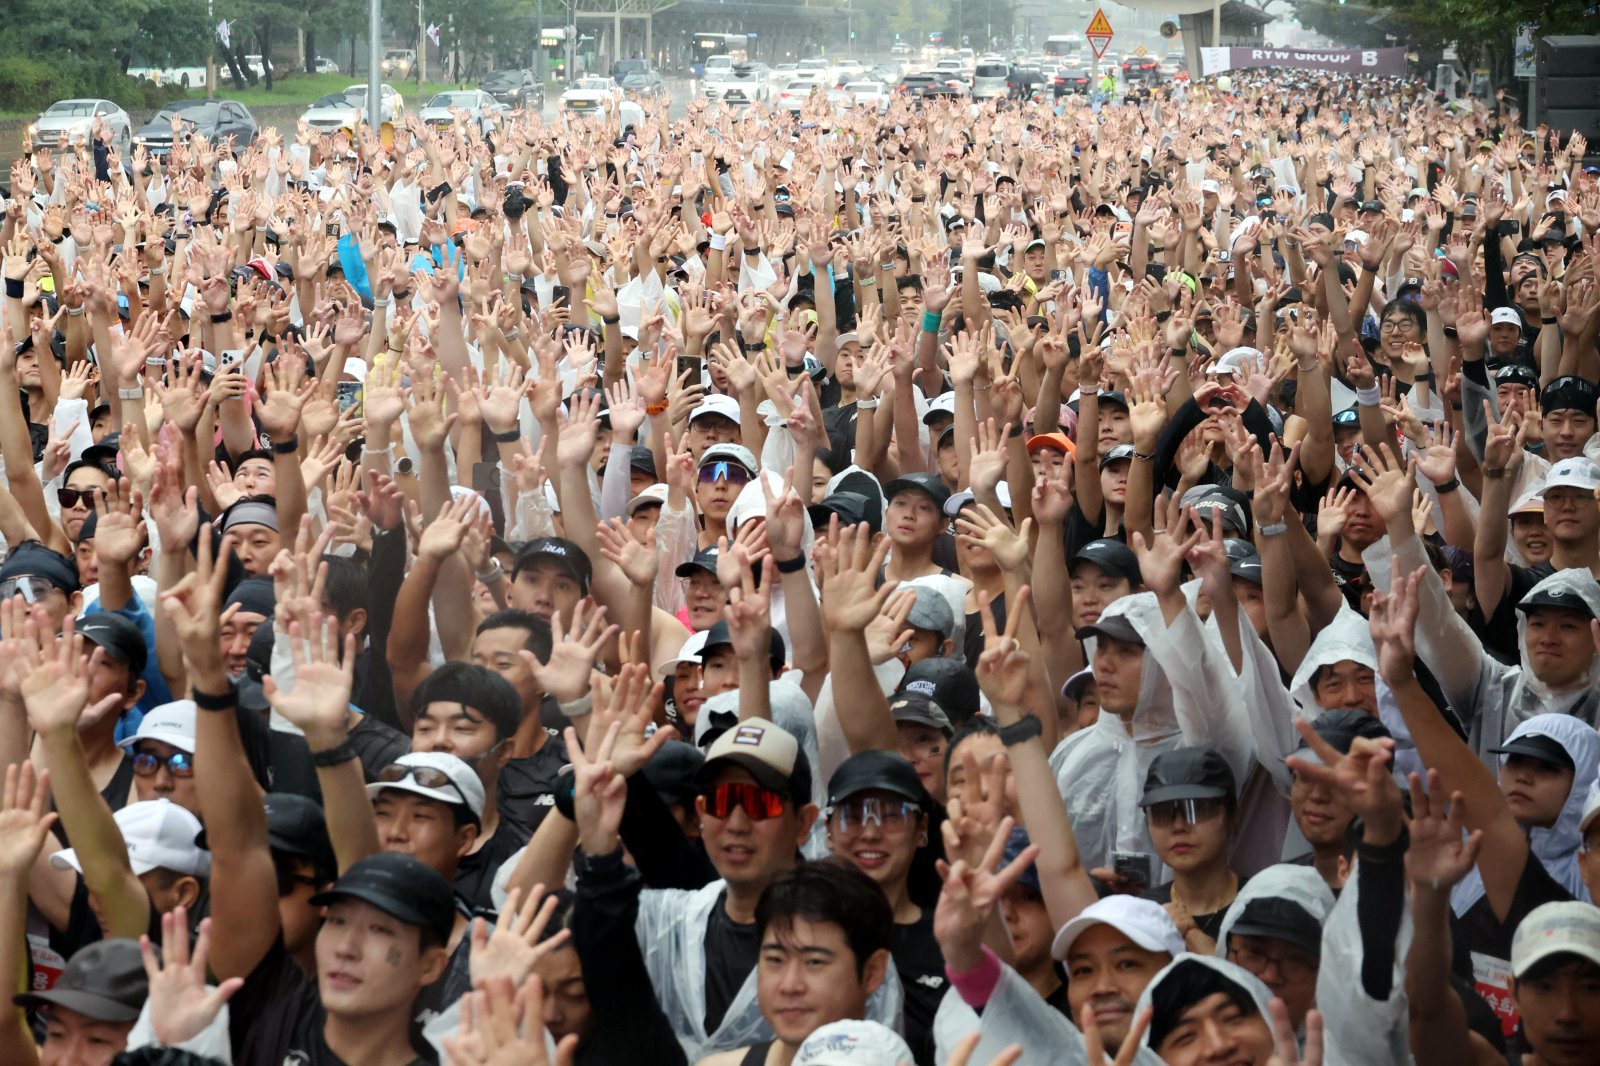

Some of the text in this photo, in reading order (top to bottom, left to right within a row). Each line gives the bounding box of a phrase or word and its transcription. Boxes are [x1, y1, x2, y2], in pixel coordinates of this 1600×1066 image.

[1252, 49, 1378, 66] RYW GROUP B
